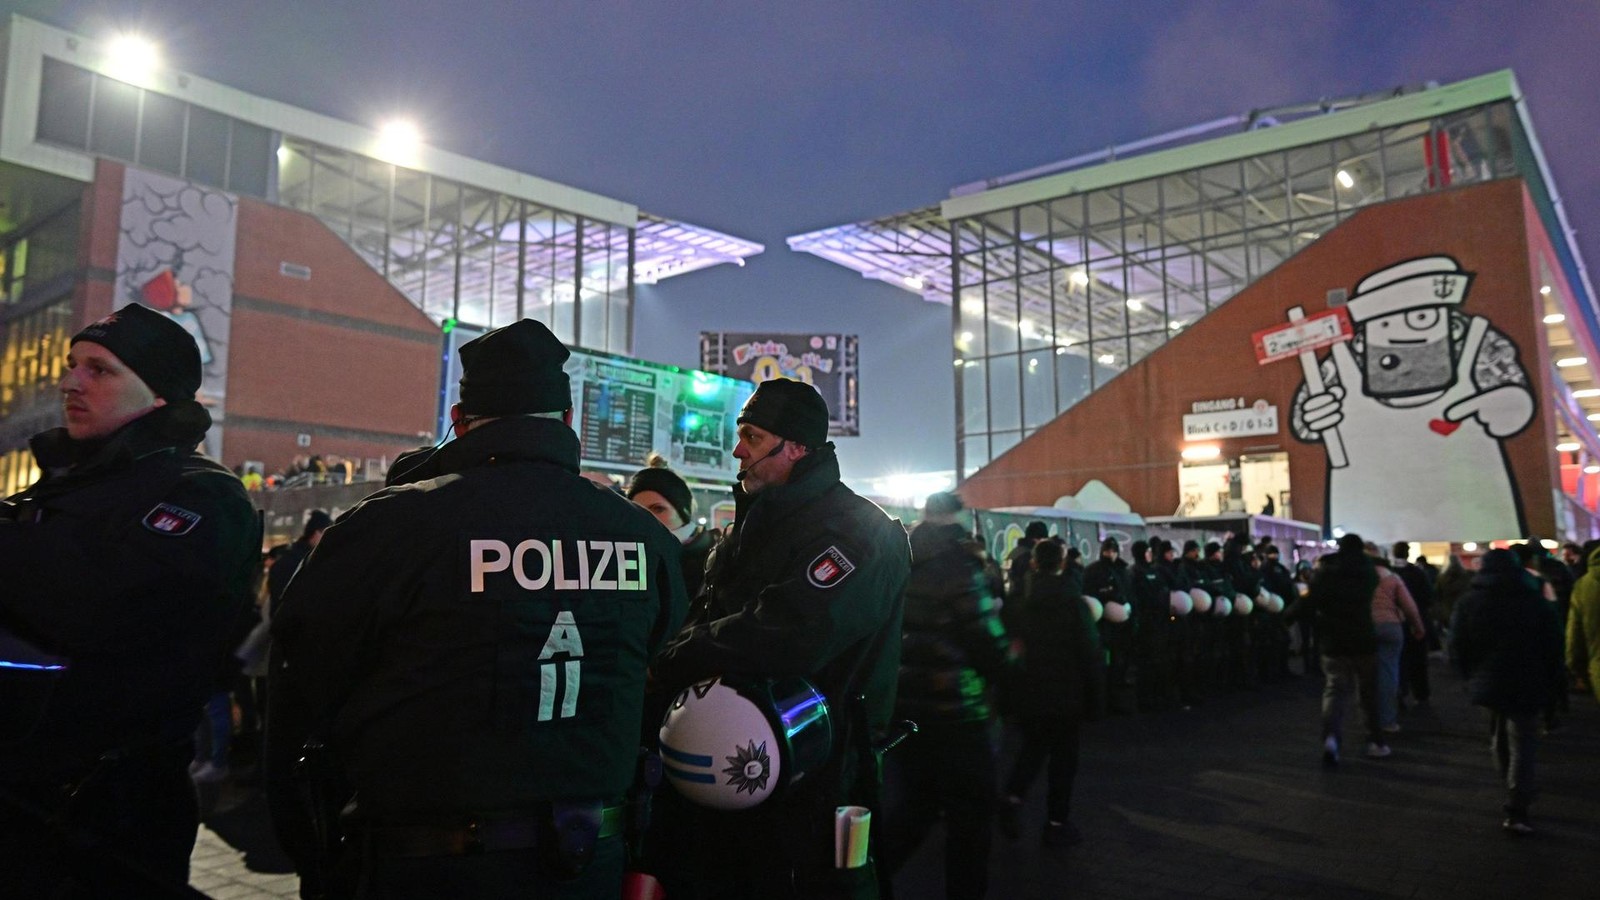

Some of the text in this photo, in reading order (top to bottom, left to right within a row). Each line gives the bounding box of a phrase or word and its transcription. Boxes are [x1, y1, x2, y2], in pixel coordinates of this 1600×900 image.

[1192, 398, 1236, 413] EINGANG
[1187, 423, 1210, 434] Block
[470, 539, 647, 592] POLIZEI
[827, 549, 851, 572] POLIZEI
[537, 611, 584, 660] A
